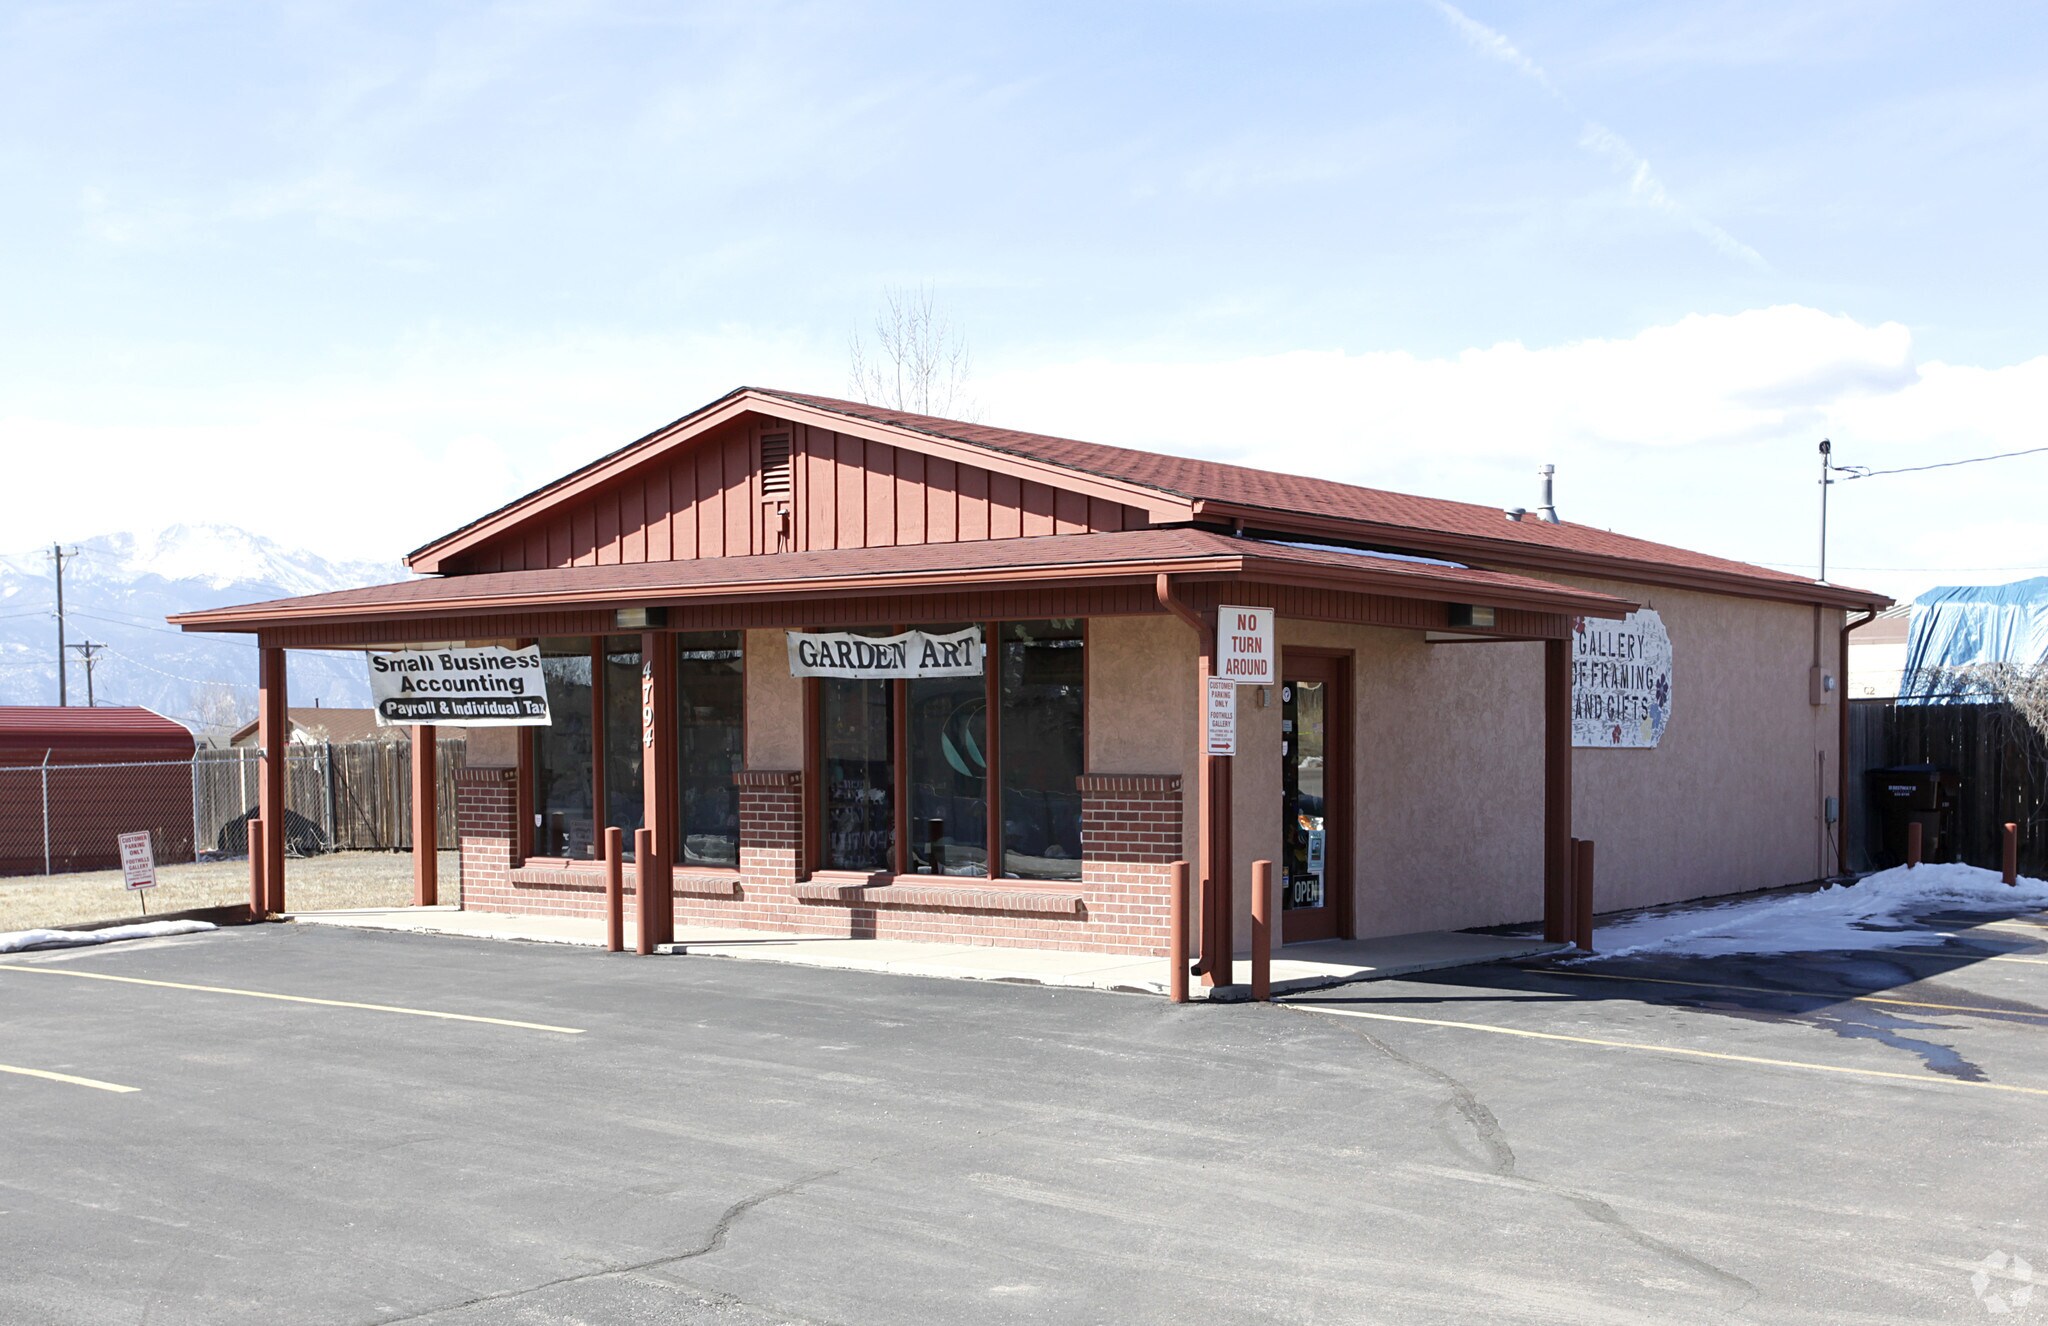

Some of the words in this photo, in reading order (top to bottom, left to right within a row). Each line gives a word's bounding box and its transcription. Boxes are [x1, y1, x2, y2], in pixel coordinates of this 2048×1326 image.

[1237, 614, 1257, 631] NO
[799, 639, 907, 669] GARDEN
[919, 636, 975, 669] ART
[1231, 636, 1262, 653] TURN
[1578, 630, 1645, 659] GALLERY
[372, 655, 434, 672] Small
[438, 653, 540, 671] Business
[1225, 658, 1268, 675] AROUND
[401, 674, 525, 694] Accounting
[1590, 661, 1654, 690] FRAMING
[1210, 681, 1234, 690] CUSTOMER
[1211, 690, 1231, 699] PARKING
[1214, 699, 1229, 707] ONLY
[386, 701, 437, 717] Payroll
[440, 701, 450, 714] &
[452, 701, 521, 715] Individual
[523, 700, 546, 714] Tax
[642, 660, 654, 748] 4794
[1575, 693, 1602, 720] AND
[1607, 694, 1648, 721] GIFTS
[1210, 711, 1233, 719] FOOTHILLS
[122, 835, 147, 843] CUSTOMER
[126, 857, 149, 865] FOOTHILLS
[1294, 880, 1318, 903] OPEN
